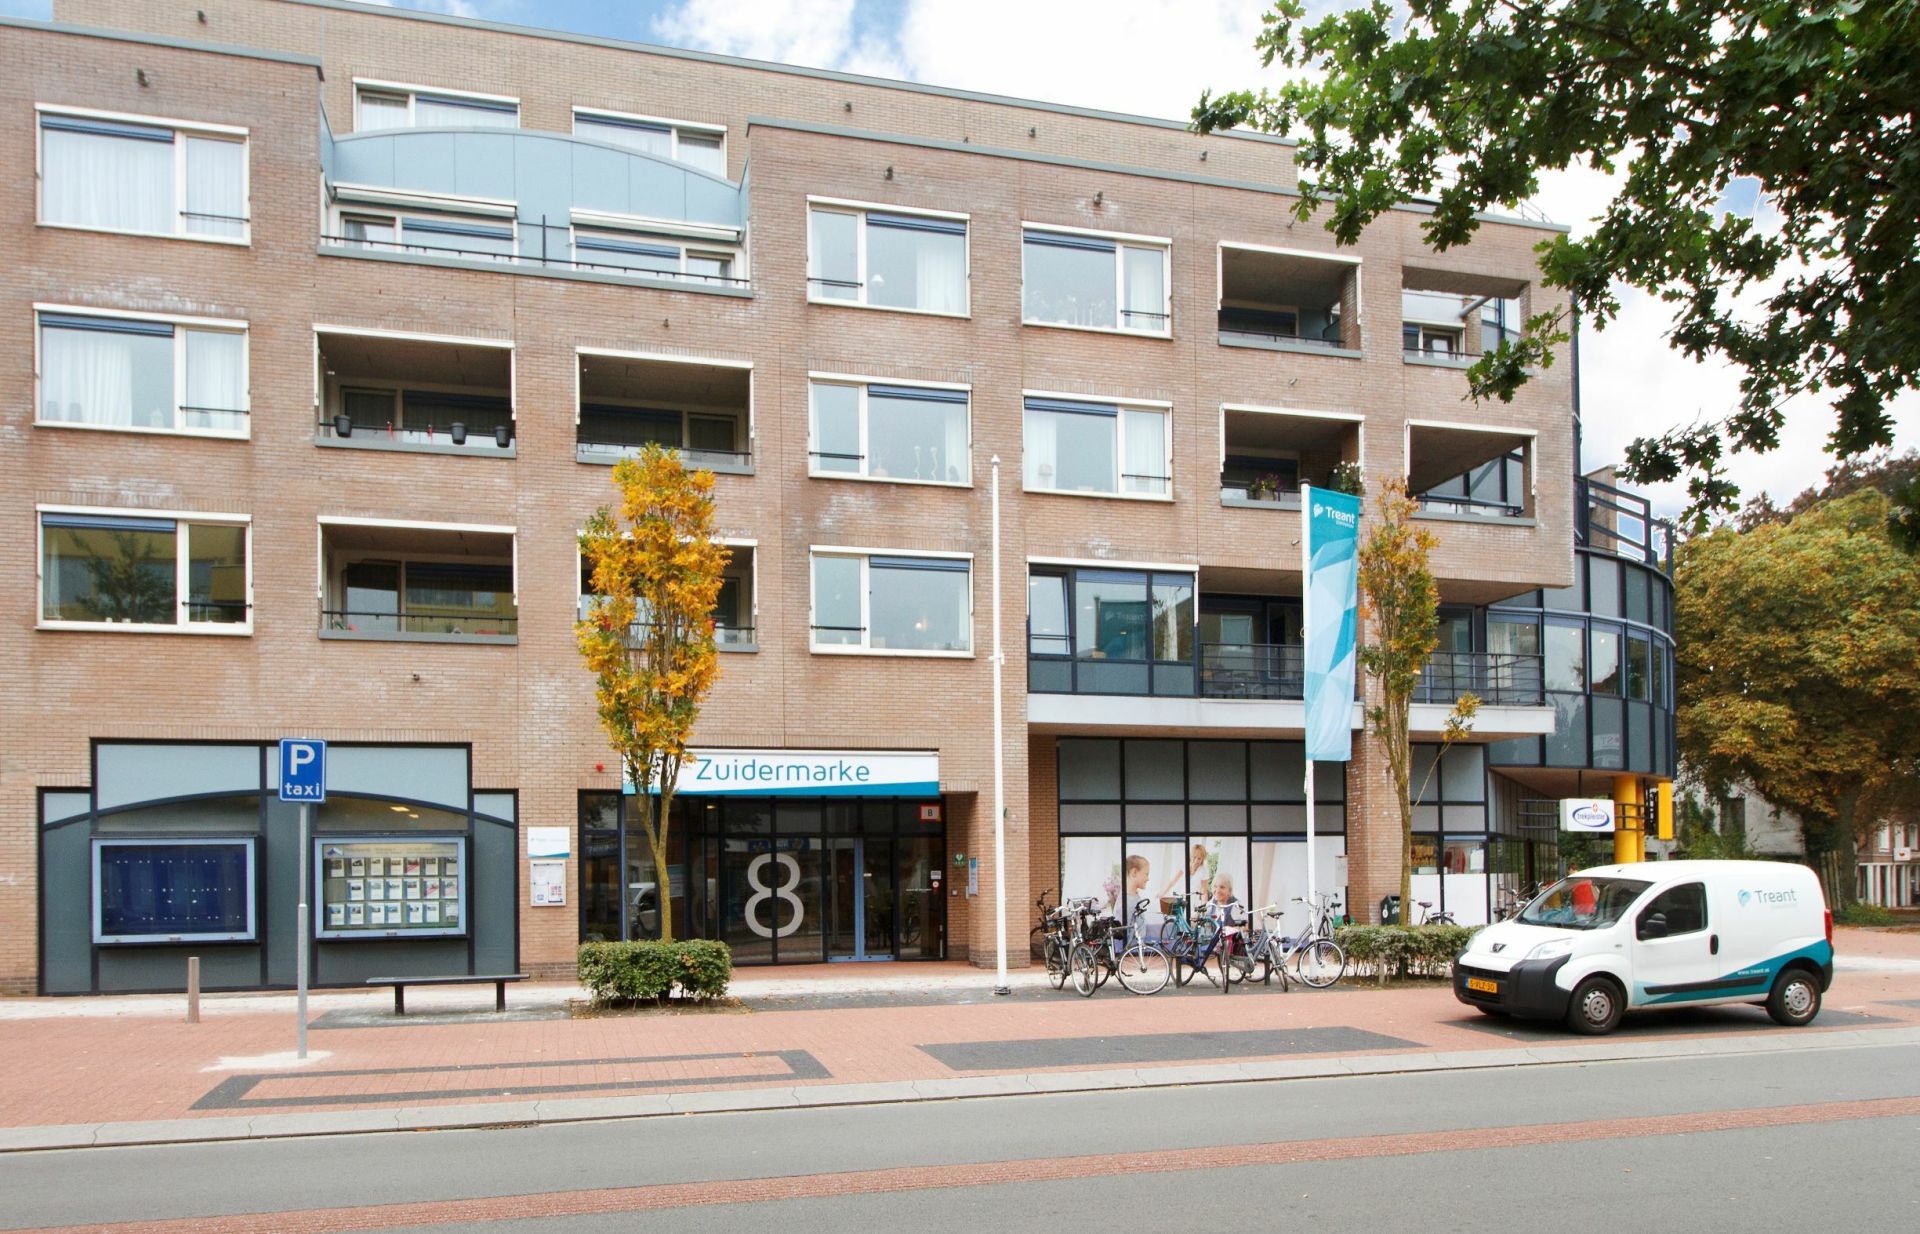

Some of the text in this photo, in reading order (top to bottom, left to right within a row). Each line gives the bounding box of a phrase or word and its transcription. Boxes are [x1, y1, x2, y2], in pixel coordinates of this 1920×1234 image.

[1325, 506, 1355, 524] Treant
[290, 744, 315, 776] P
[696, 758, 870, 782] Zuidermarke
[284, 782, 320, 796] taxi
[744, 852, 804, 938] 8
[1753, 888, 1797, 904] Treant
